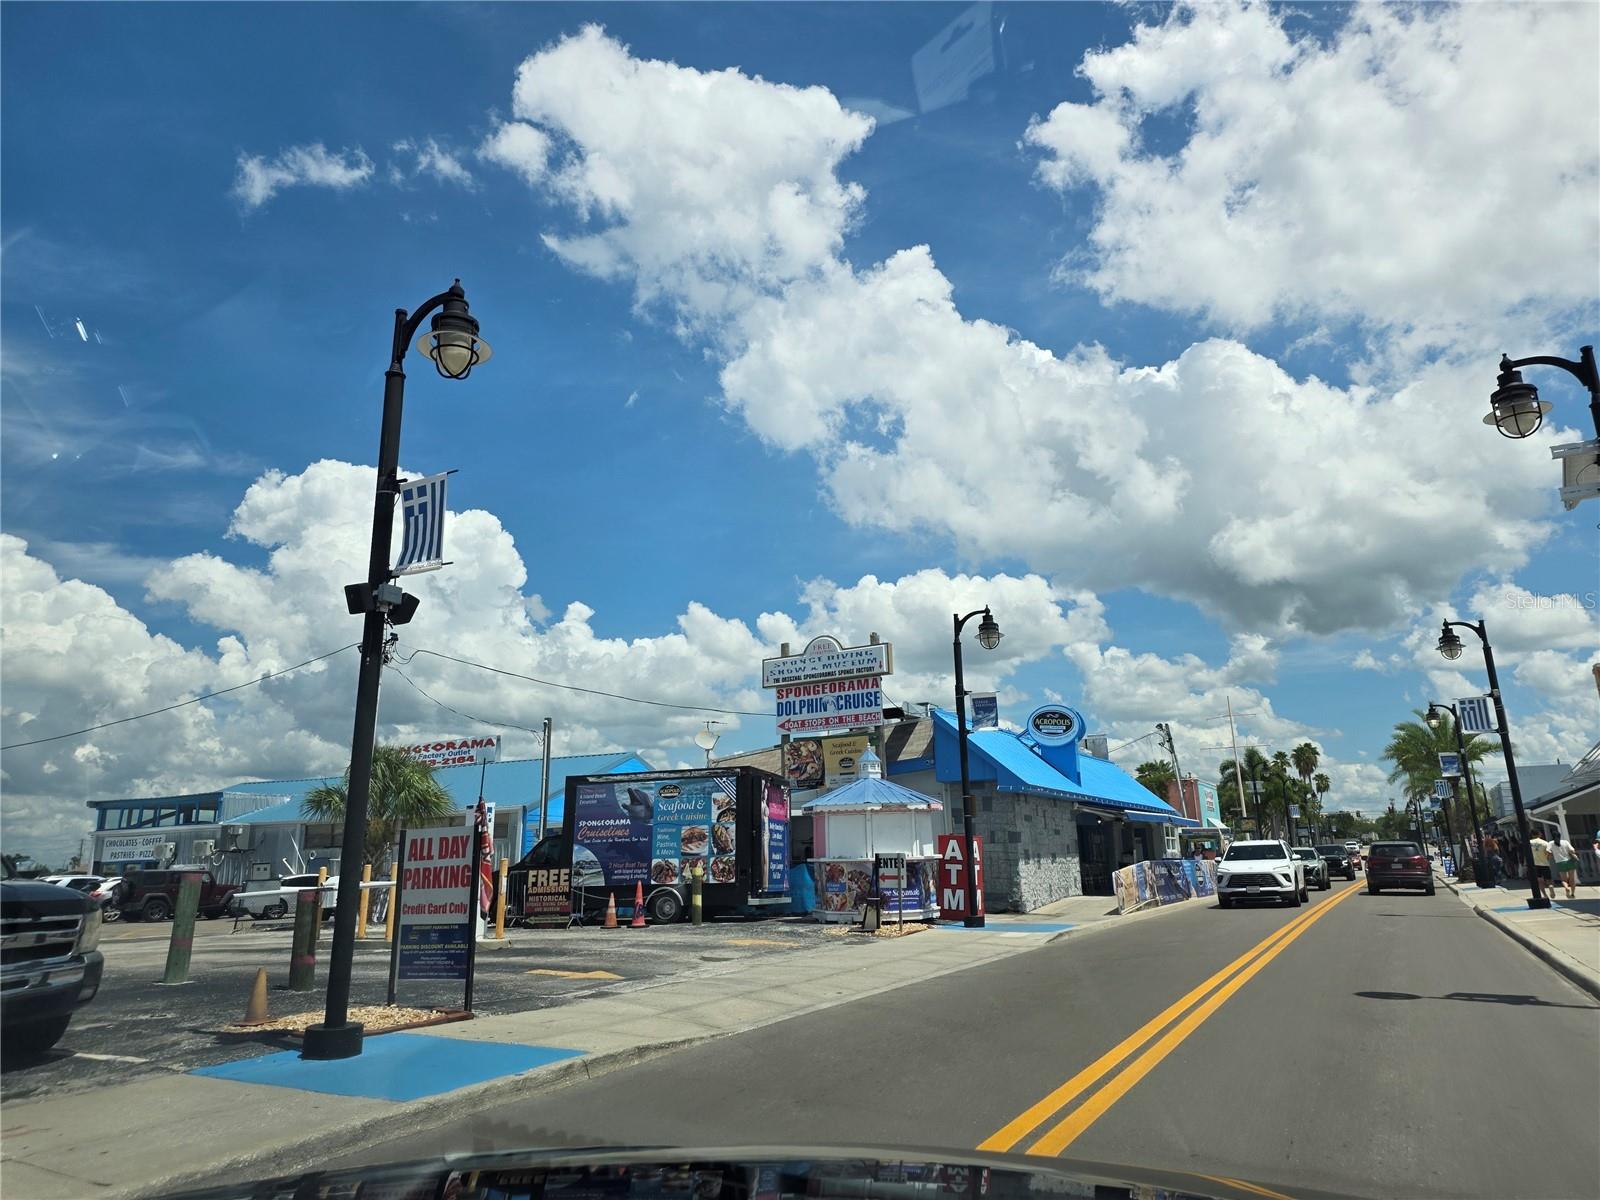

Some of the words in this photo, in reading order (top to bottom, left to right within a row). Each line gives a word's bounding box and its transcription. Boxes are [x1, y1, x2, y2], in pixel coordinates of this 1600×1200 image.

[813, 643, 833, 651] FREE
[774, 656, 823, 669] SPONGE
[827, 649, 874, 661] DIVING
[769, 665, 807, 677] SHOW
[822, 657, 877, 670] MUSEUM
[777, 677, 880, 700] SPONGEORAMA
[777, 697, 828, 717] DOLPHIN
[836, 690, 880, 711] CRUISE
[784, 720, 802, 729] BOAT
[804, 718, 826, 727] STOPS
[842, 714, 855, 722] THE
[858, 712, 880, 721] BEACH
[1034, 718, 1071, 726] ACROPOLIS
[418, 751, 446, 761] Factory
[447, 749, 471, 757] Outlet
[421, 755, 475, 766] 3-2164
[659, 799, 695, 812] Seafood
[697, 799, 706, 810] &
[578, 818, 632, 827] SPONGEORAMA
[657, 813, 679, 821] Greek
[680, 811, 707, 820] Cuisine
[577, 826, 630, 840] Cruiselines
[105, 838, 138, 848] CHOCOLATES
[408, 838, 434, 861] ALL
[438, 835, 470, 860] DAY
[110, 851, 136, 859] PASTRIES
[879, 857, 905, 869] ENTER
[402, 864, 472, 890] PARKING
[527, 868, 570, 888] FREE
[943, 839, 965, 911] ATM
[527, 885, 570, 893] ADMISSION
[402, 903, 427, 915] Credit
[427, 902, 448, 915] Card
[448, 901, 469, 915] Only
